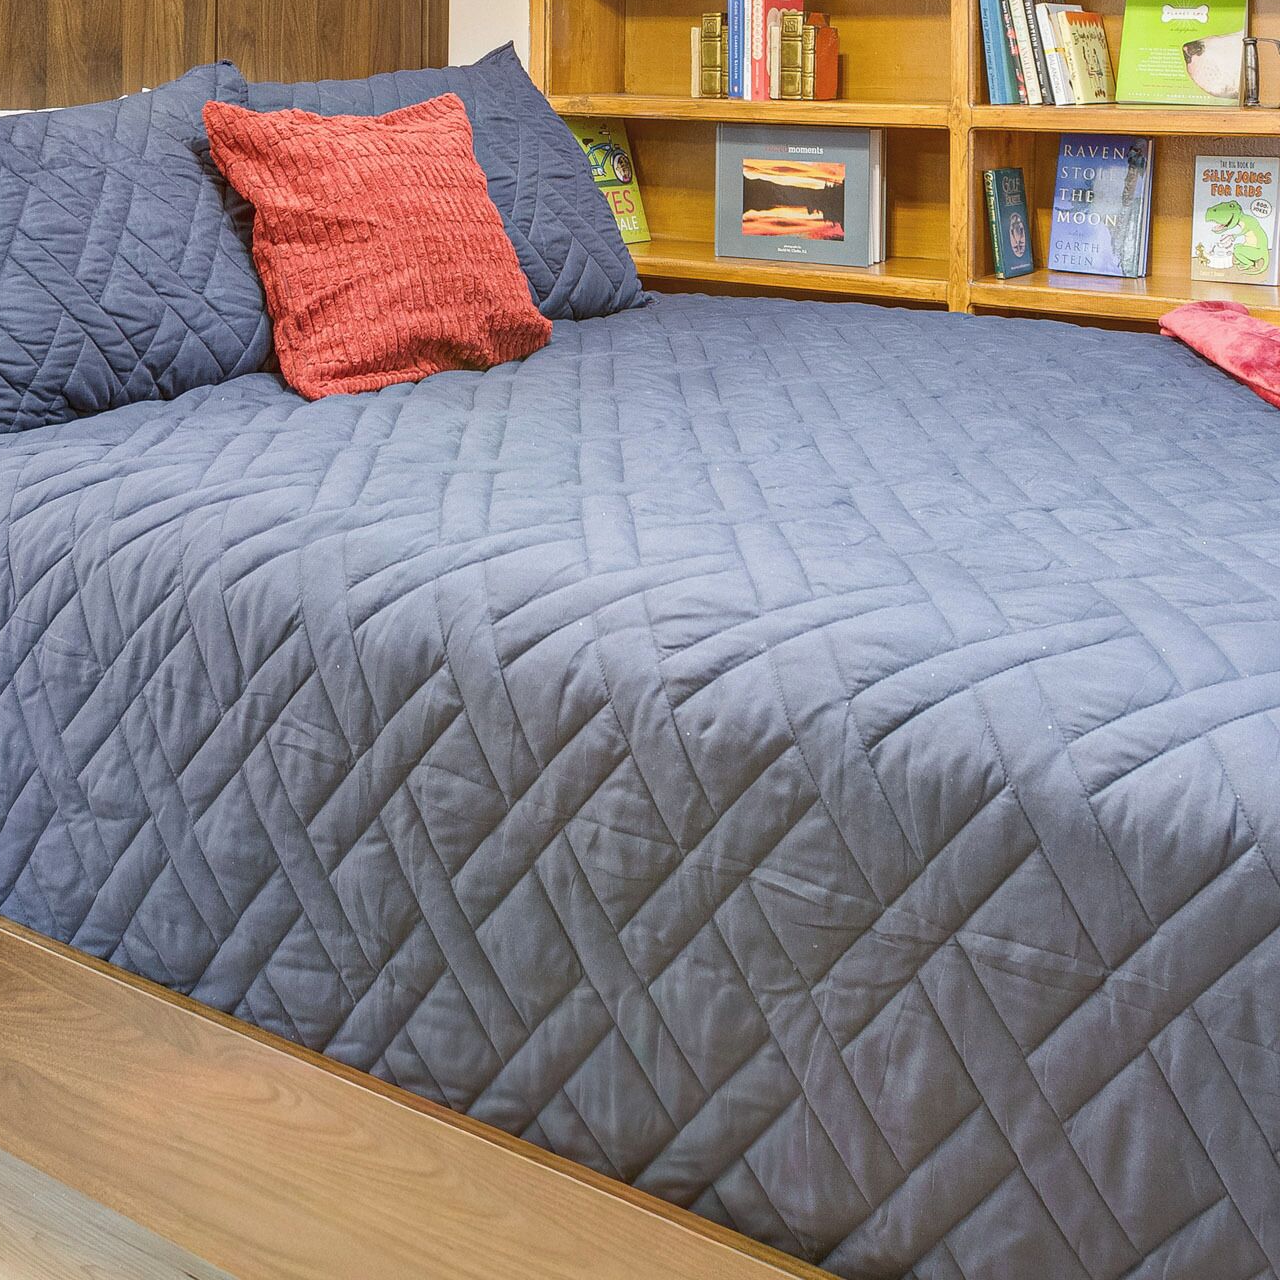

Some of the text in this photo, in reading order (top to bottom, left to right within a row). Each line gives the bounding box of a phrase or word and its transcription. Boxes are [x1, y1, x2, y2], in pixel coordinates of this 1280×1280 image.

[1024, 1, 1039, 49] DISRUPTION
[788, 146, 823, 155] moments
[1063, 144, 1126, 160] RAVEN
[1237, 161, 1249, 169] BOOK
[1250, 161, 1255, 169] OF
[1202, 169, 1273, 184] SILLY JOKES
[1002, 176, 1021, 194] GOLF
[1210, 183, 1263, 197] FOR KIDS
[1059, 188, 1094, 203] THE
[1057, 210, 1117, 226] MOON
[1055, 241, 1099, 253] GARTH
[1054, 254, 1093, 266] STEIN
